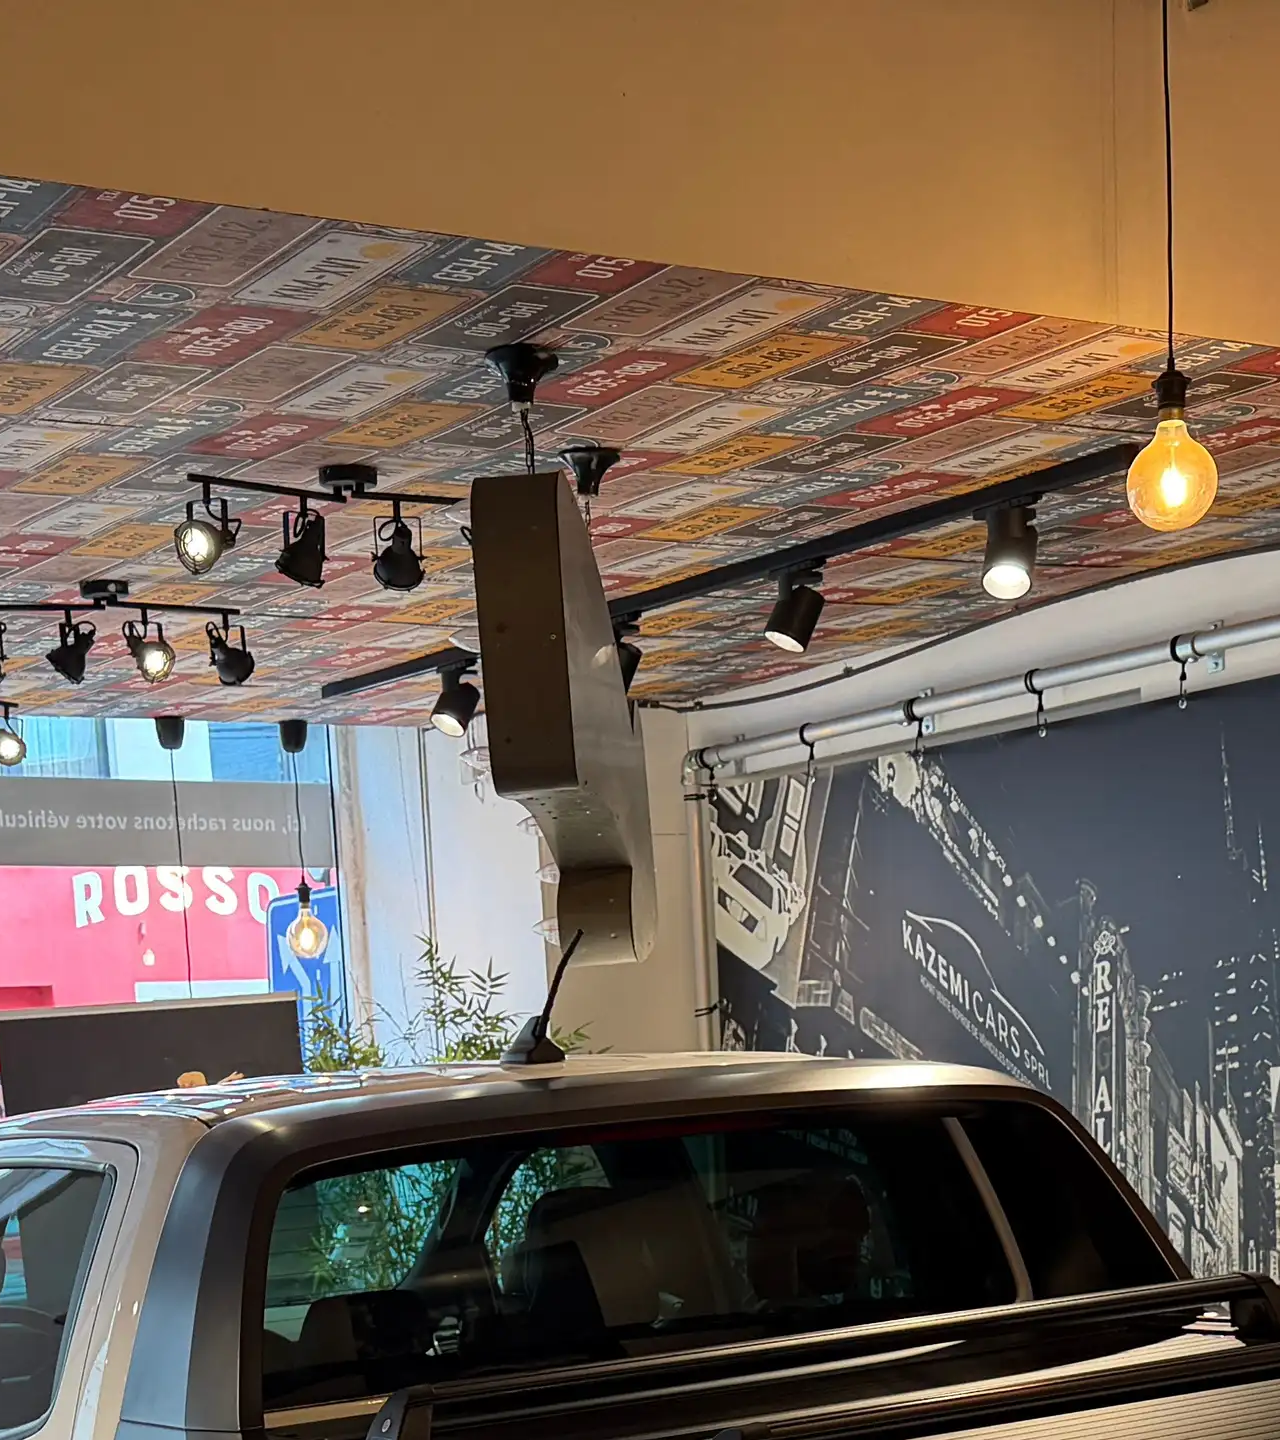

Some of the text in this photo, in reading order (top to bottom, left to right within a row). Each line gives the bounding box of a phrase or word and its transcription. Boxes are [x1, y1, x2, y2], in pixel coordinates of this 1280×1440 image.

[72, 865, 280, 928] ROSSO
[902, 920, 970, 1011] KAZEMI
[973, 990, 1020, 1058] CARS
[1024, 1049, 1052, 1091] SPRL
[1094, 960, 1113, 1155] REGAL
